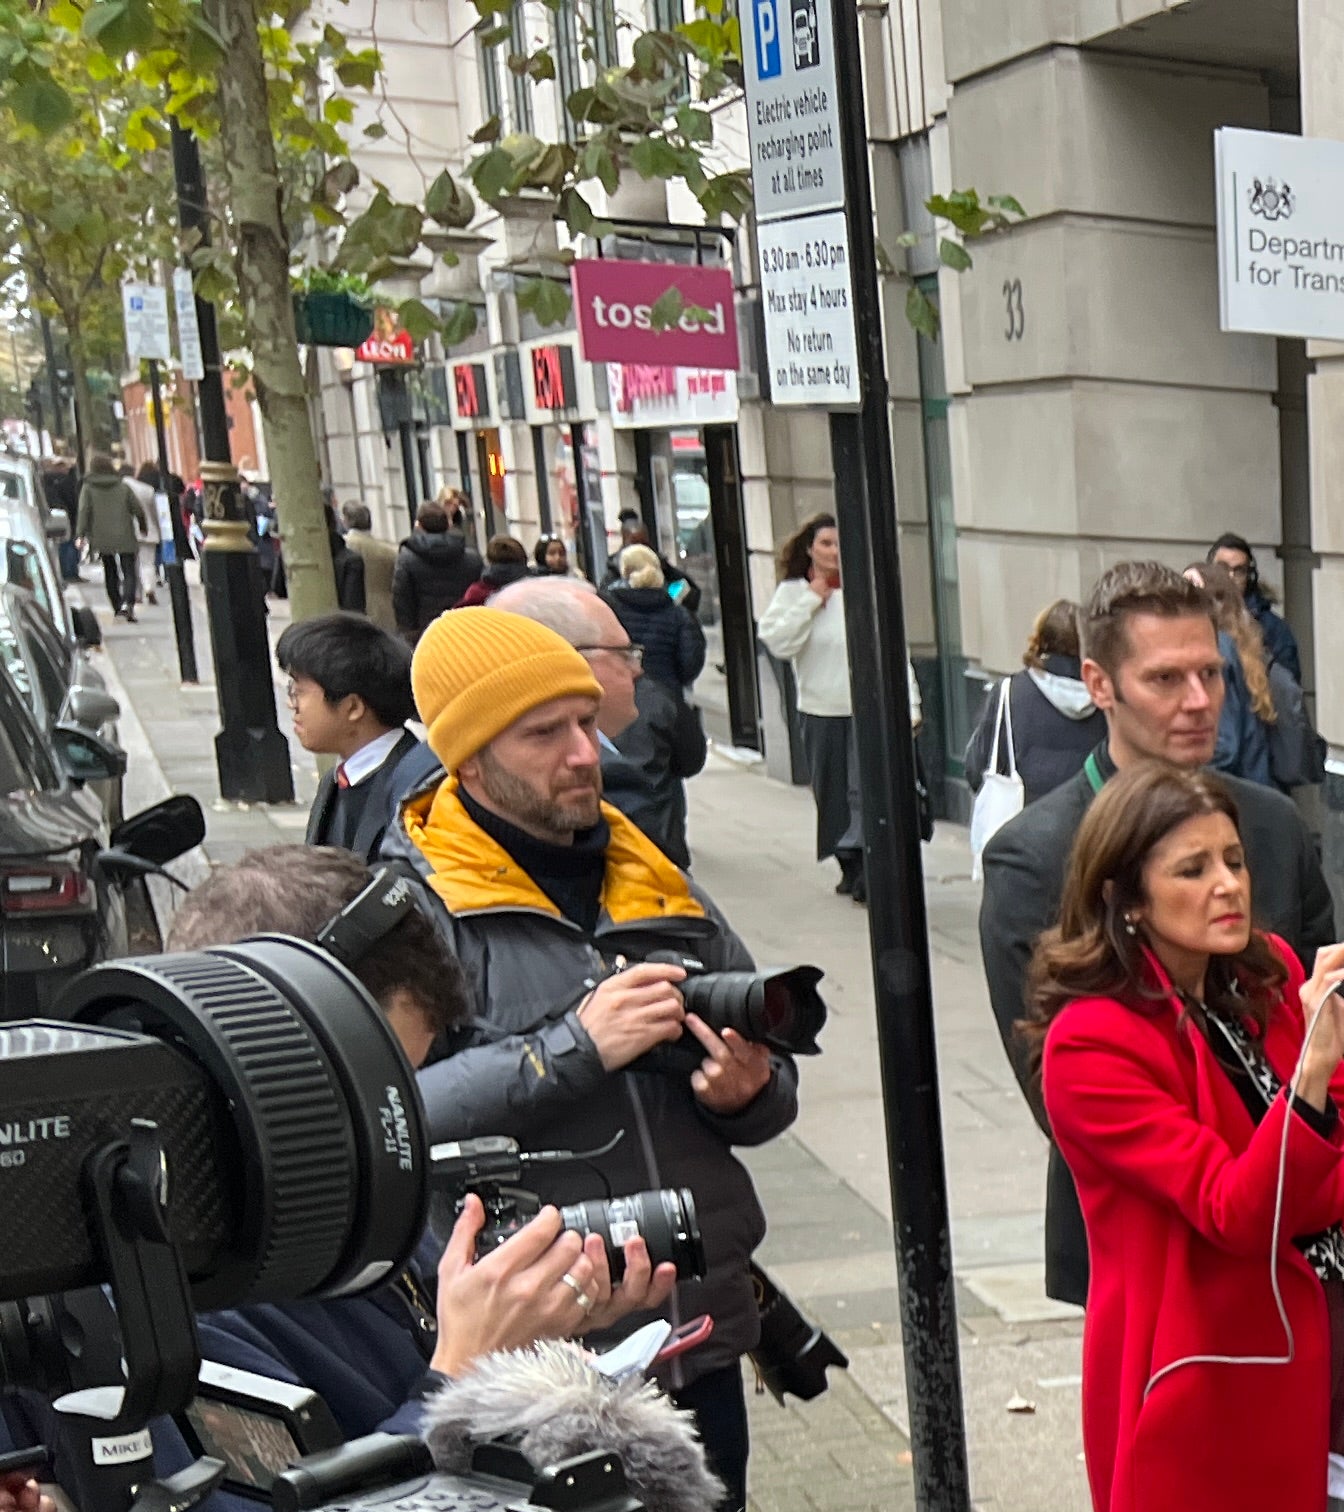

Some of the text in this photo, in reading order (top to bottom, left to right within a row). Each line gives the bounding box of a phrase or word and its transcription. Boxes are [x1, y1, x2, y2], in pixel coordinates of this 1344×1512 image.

[756, 86, 827, 126] Electric vehicle
[757, 123, 833, 162] recharging point
[771, 165, 824, 194] at all times
[762, 246, 784, 274] 8.30
[785, 251, 800, 271] am
[805, 240, 828, 268] 6.30
[830, 243, 845, 270] pm
[1249, 261, 1281, 286] for
[767, 283, 848, 315] Max stay 4 hours
[1003, 278, 1025, 342] 33
[787, 328, 833, 353] No return
[776, 360, 850, 389] on the same day
